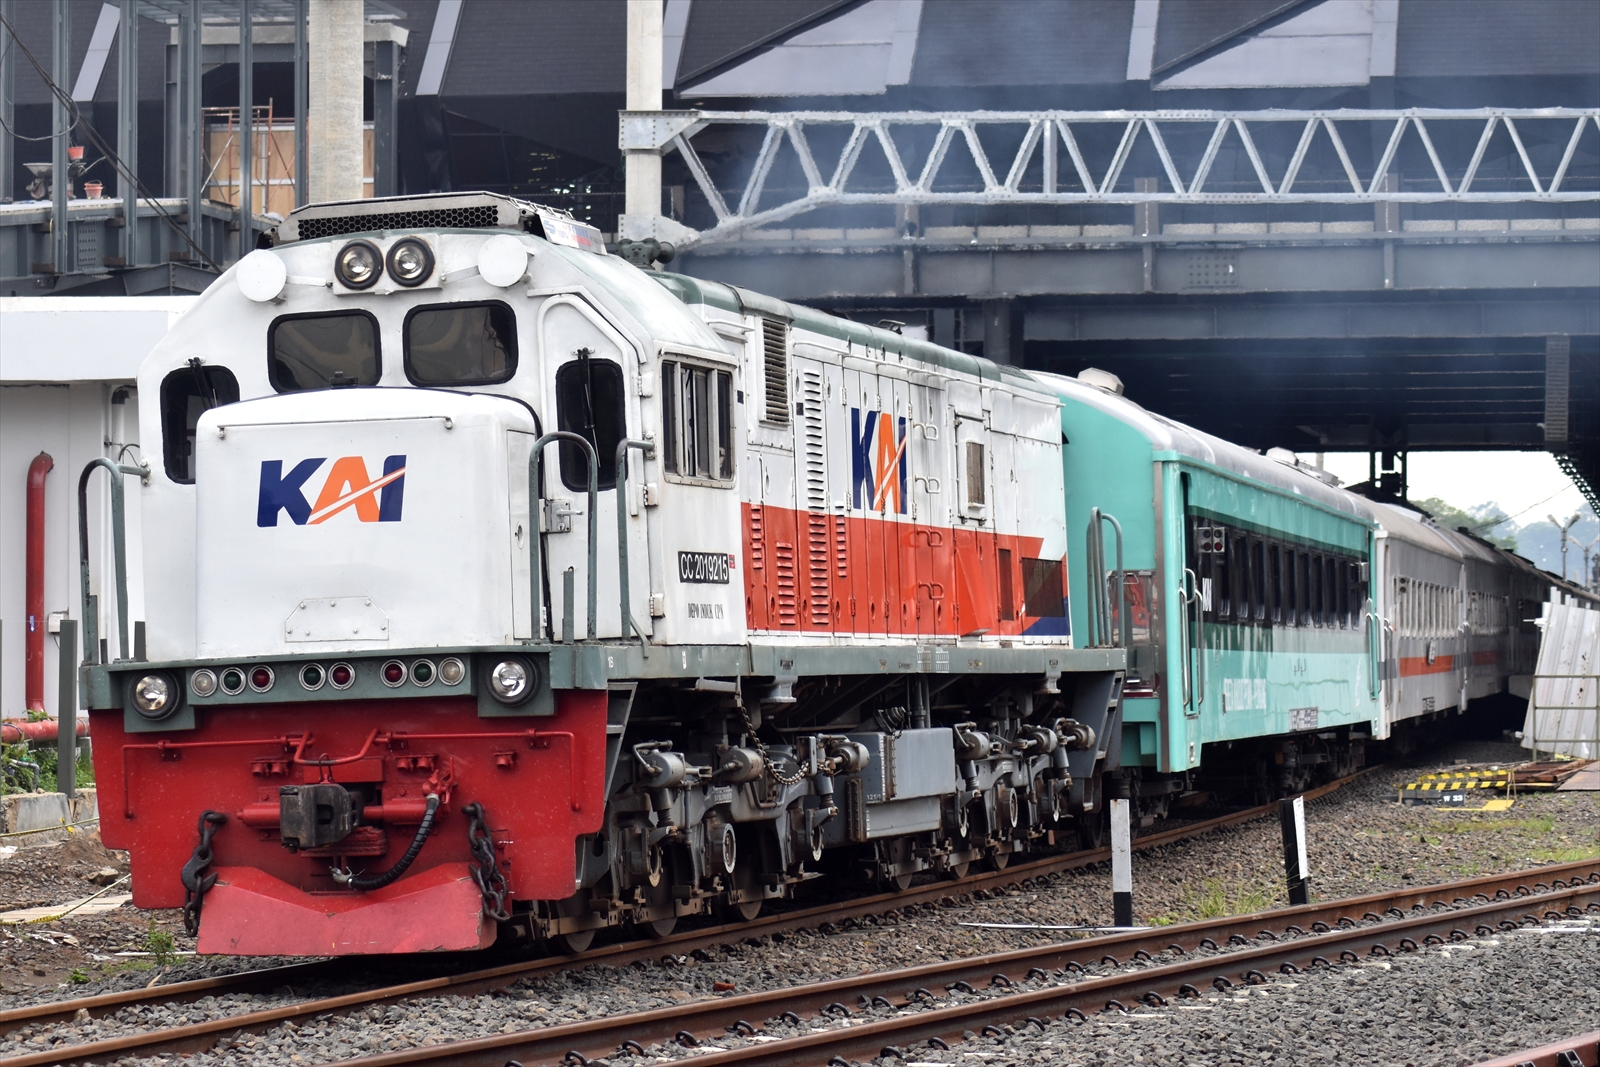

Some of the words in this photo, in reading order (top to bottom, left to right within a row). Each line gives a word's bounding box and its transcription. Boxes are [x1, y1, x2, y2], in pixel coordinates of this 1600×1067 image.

[851, 407, 907, 515] KAI
[257, 454, 407, 528] KAI
[681, 553, 694, 579] CC
[695, 554, 728, 581] 2019215
[687, 603, 699, 618] DEPO
